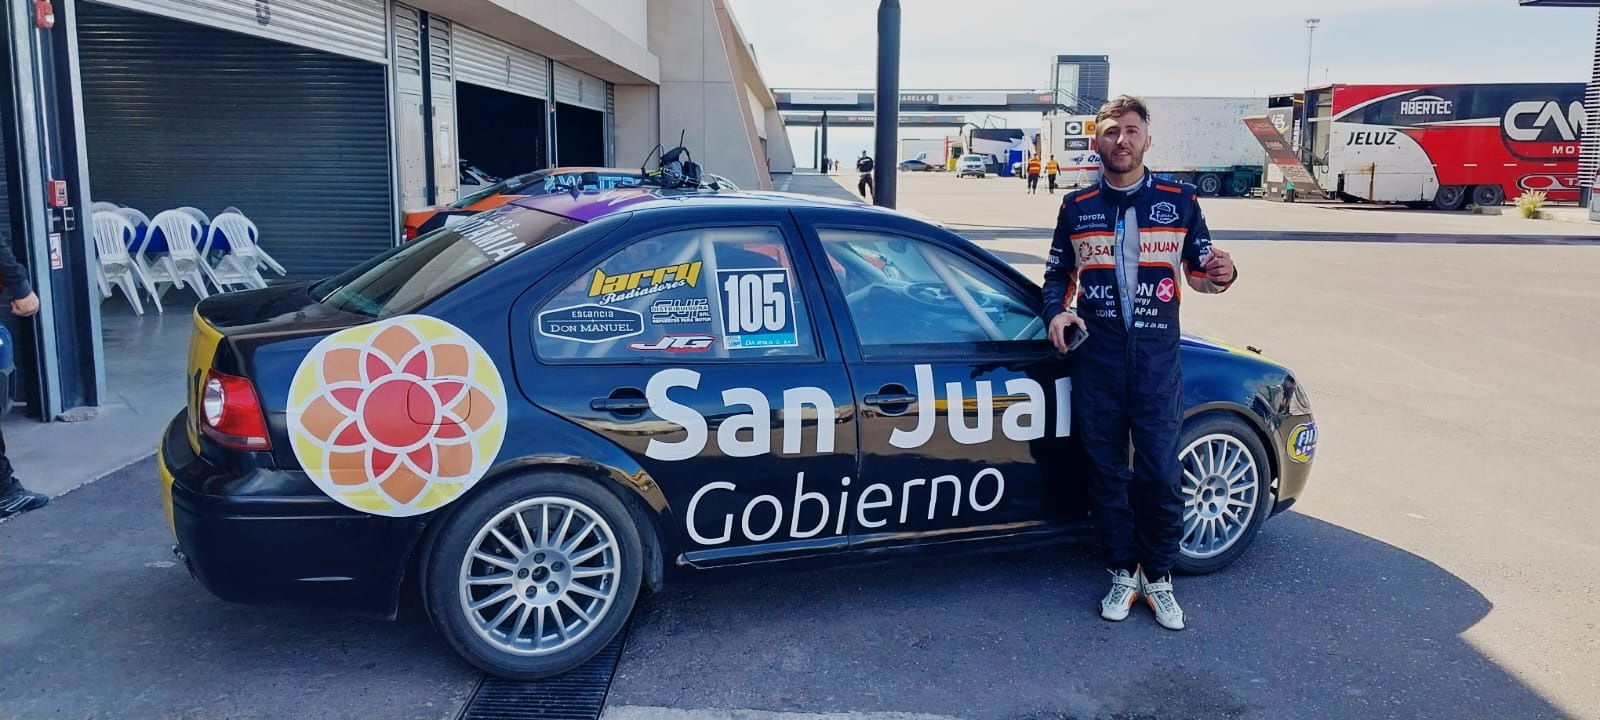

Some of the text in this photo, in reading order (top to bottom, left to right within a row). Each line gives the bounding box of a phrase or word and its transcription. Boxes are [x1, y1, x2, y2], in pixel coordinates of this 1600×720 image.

[1400, 101, 1452, 115] ABERTEC
[1347, 131, 1397, 146] JELUZ
[1078, 213, 1106, 222] TOYOTA
[453, 217, 527, 262] OTAMIA
[1094, 245, 1110, 257] SA
[1152, 241, 1179, 253] JUAN
[599, 280, 686, 305] Radiadores
[725, 273, 786, 333] 105
[580, 323, 634, 332] MANUEL
[644, 368, 835, 461] San
[686, 467, 1005, 545] Gobierno
